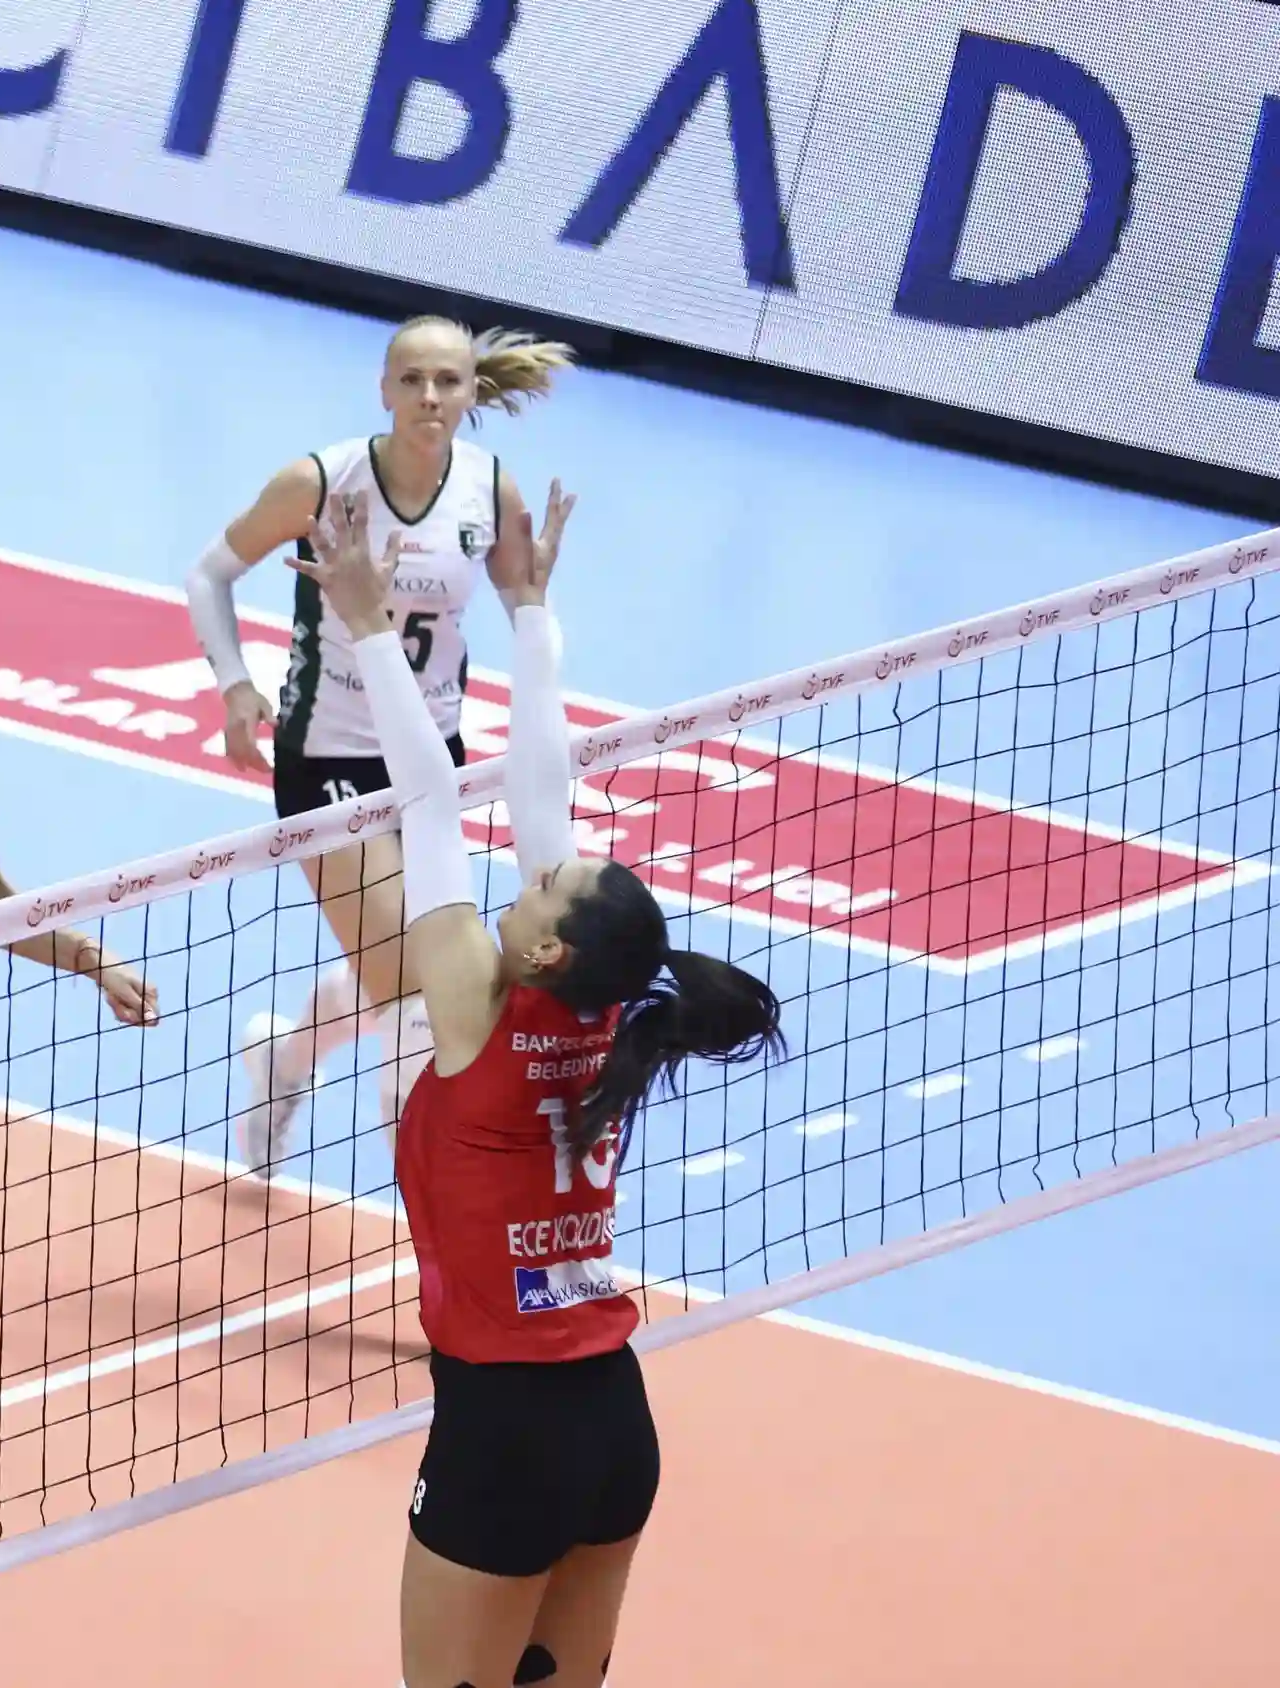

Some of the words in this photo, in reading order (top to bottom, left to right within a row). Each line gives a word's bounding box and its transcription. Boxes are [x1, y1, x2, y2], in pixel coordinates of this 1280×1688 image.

[1247, 547, 1269, 567] TVF
[394, 577, 448, 595] KOZA
[1176, 568, 1201, 586] TVF
[1107, 589, 1131, 607] TVF
[1037, 610, 1062, 627] TVF
[386, 611, 439, 673] 5
[966, 631, 989, 650] TVF
[893, 652, 918, 671] TVF
[821, 672, 845, 692] TVF
[747, 694, 774, 714] TVF
[673, 717, 699, 735] TVF
[598, 738, 622, 757] TVF
[365, 804, 394, 826] TVF
[287, 829, 316, 850] TVF
[207, 851, 236, 872] TVF
[128, 874, 156, 894] TVF
[47, 897, 75, 917] TVF
[507, 1219, 551, 1258] ECE
